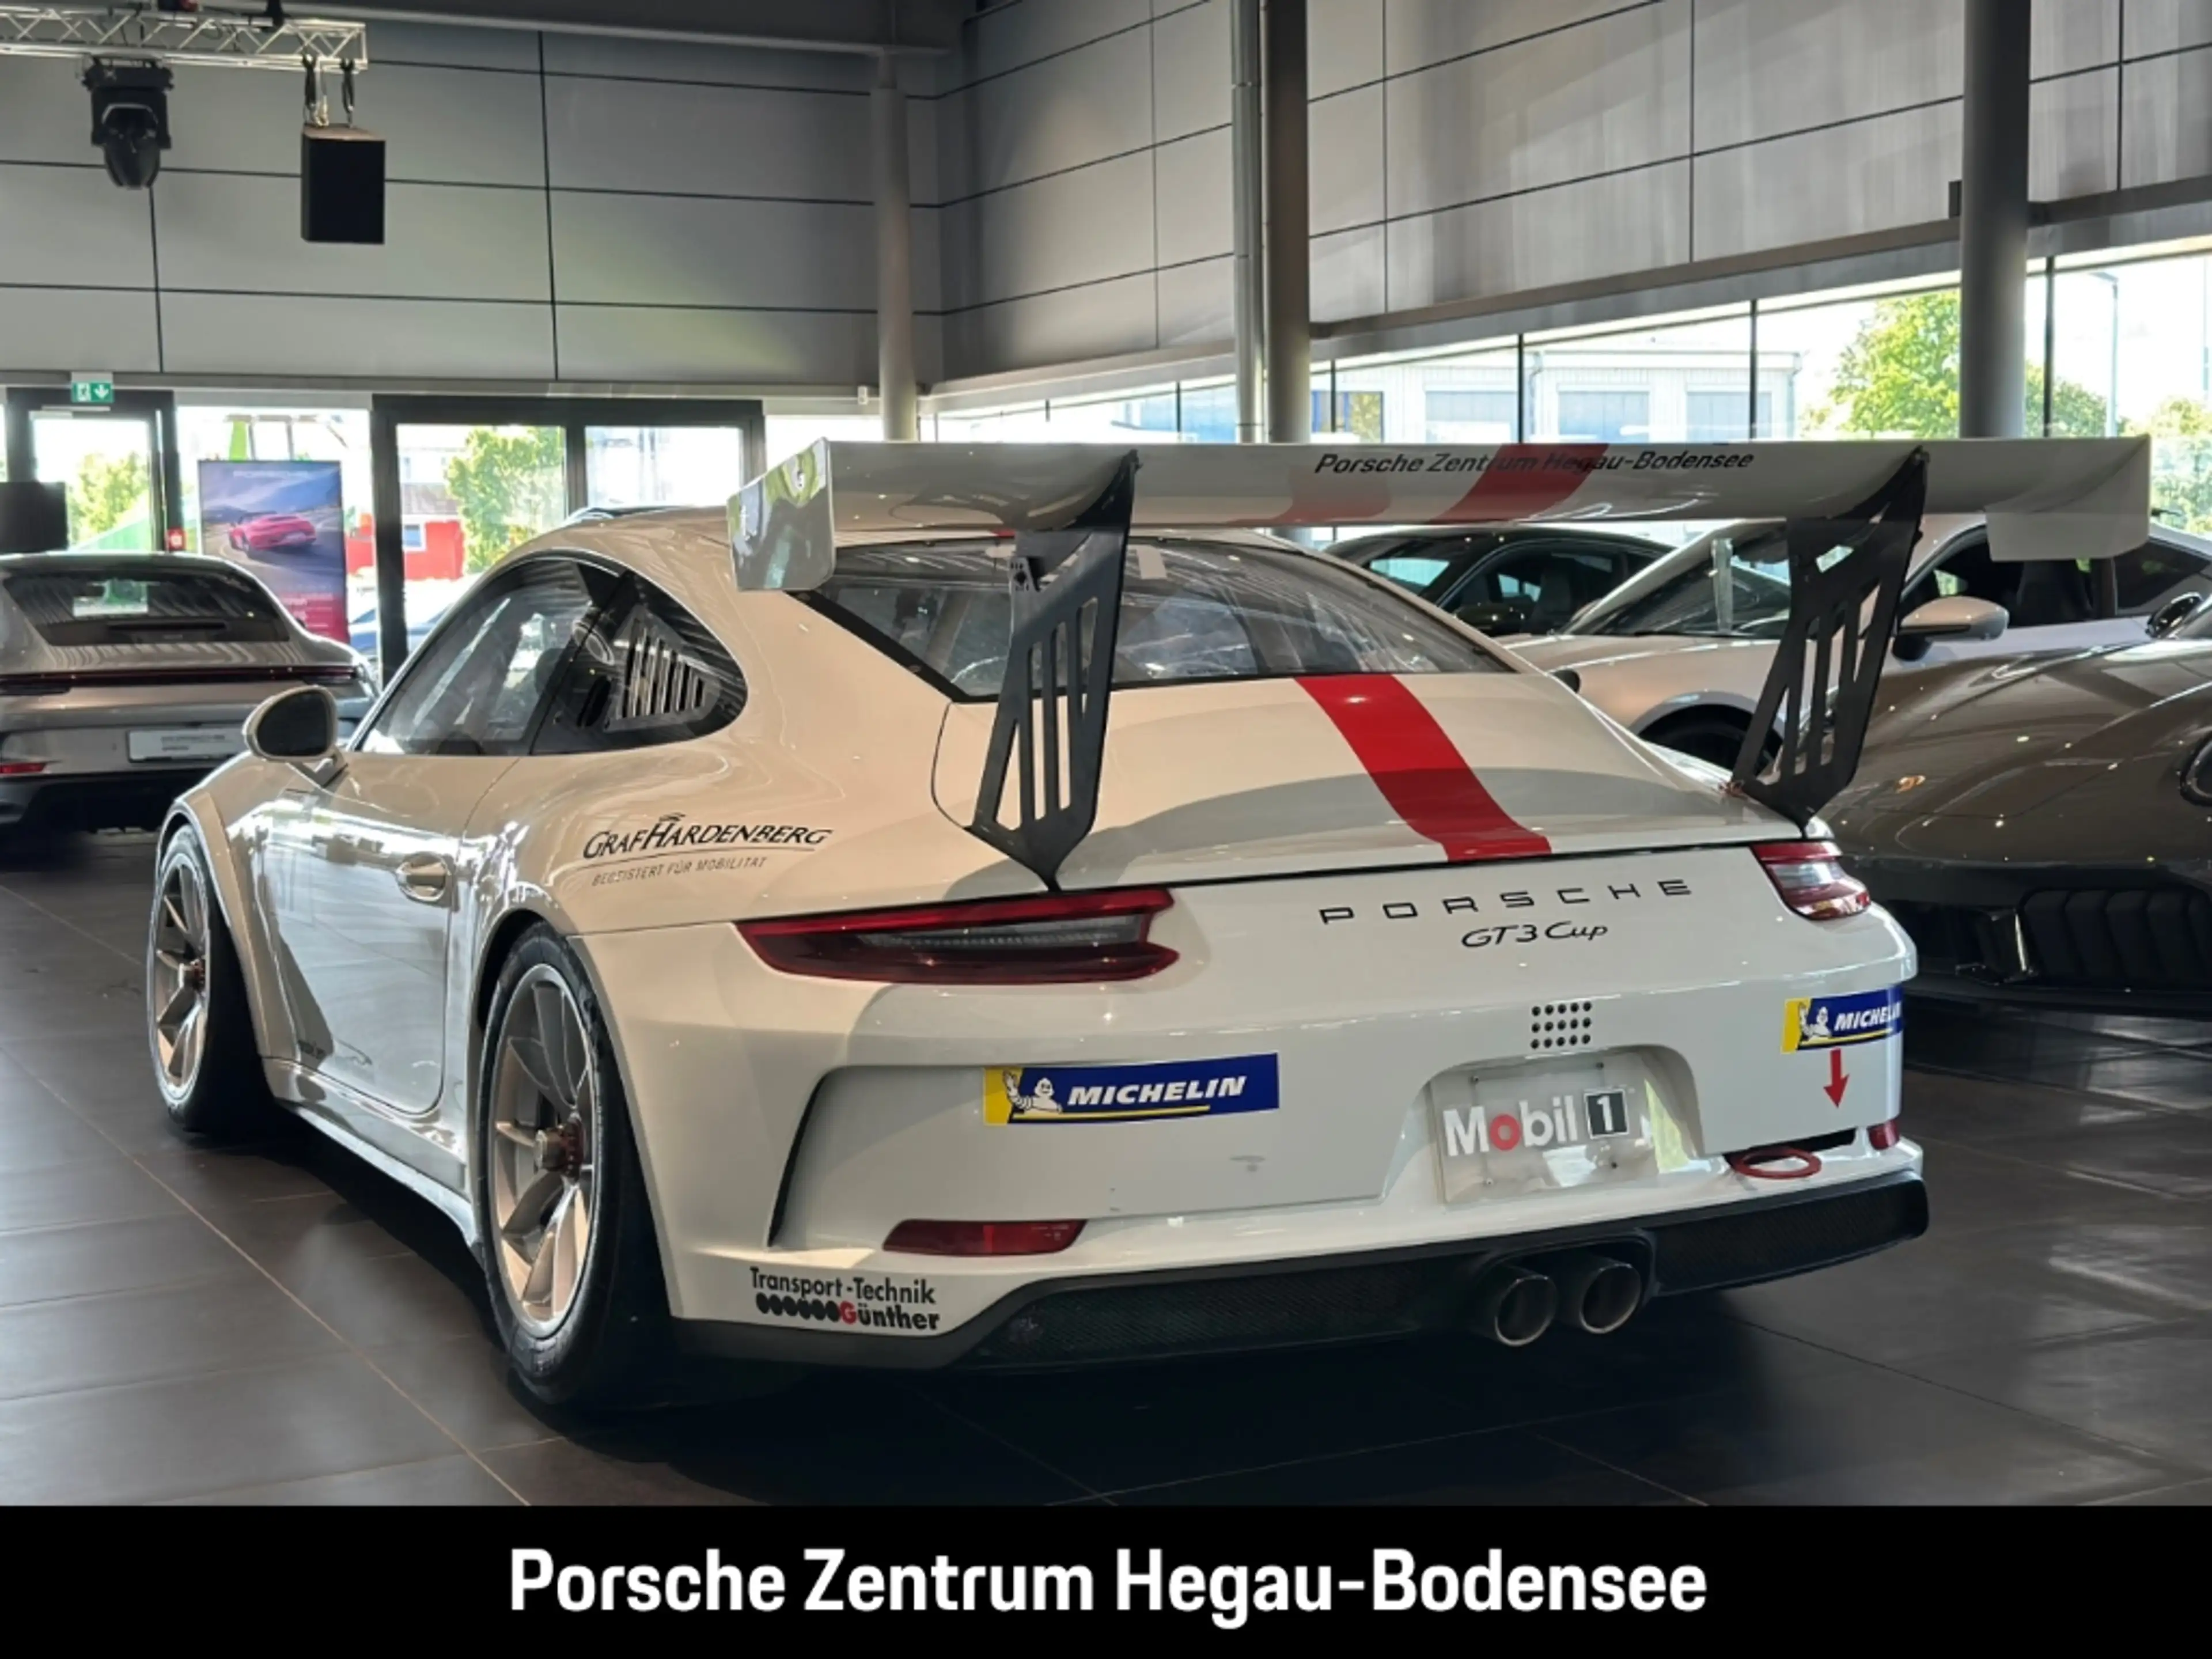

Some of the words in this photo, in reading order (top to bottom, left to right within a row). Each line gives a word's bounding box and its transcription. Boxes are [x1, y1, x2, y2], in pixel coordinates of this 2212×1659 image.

[1315, 453, 1425, 474] Porsche
[1426, 453, 1539, 472] Zentrum
[1543, 450, 1754, 475] Hegau-Bodensee
[1319, 879, 1692, 924] PORSCHE
[1461, 923, 1538, 948] GT3
[1545, 921, 1608, 941] Cup
[1067, 1075, 1247, 1105] MICHELIN
[1443, 1095, 1578, 1156] Mobil
[840, 1300, 940, 1330] Günther
